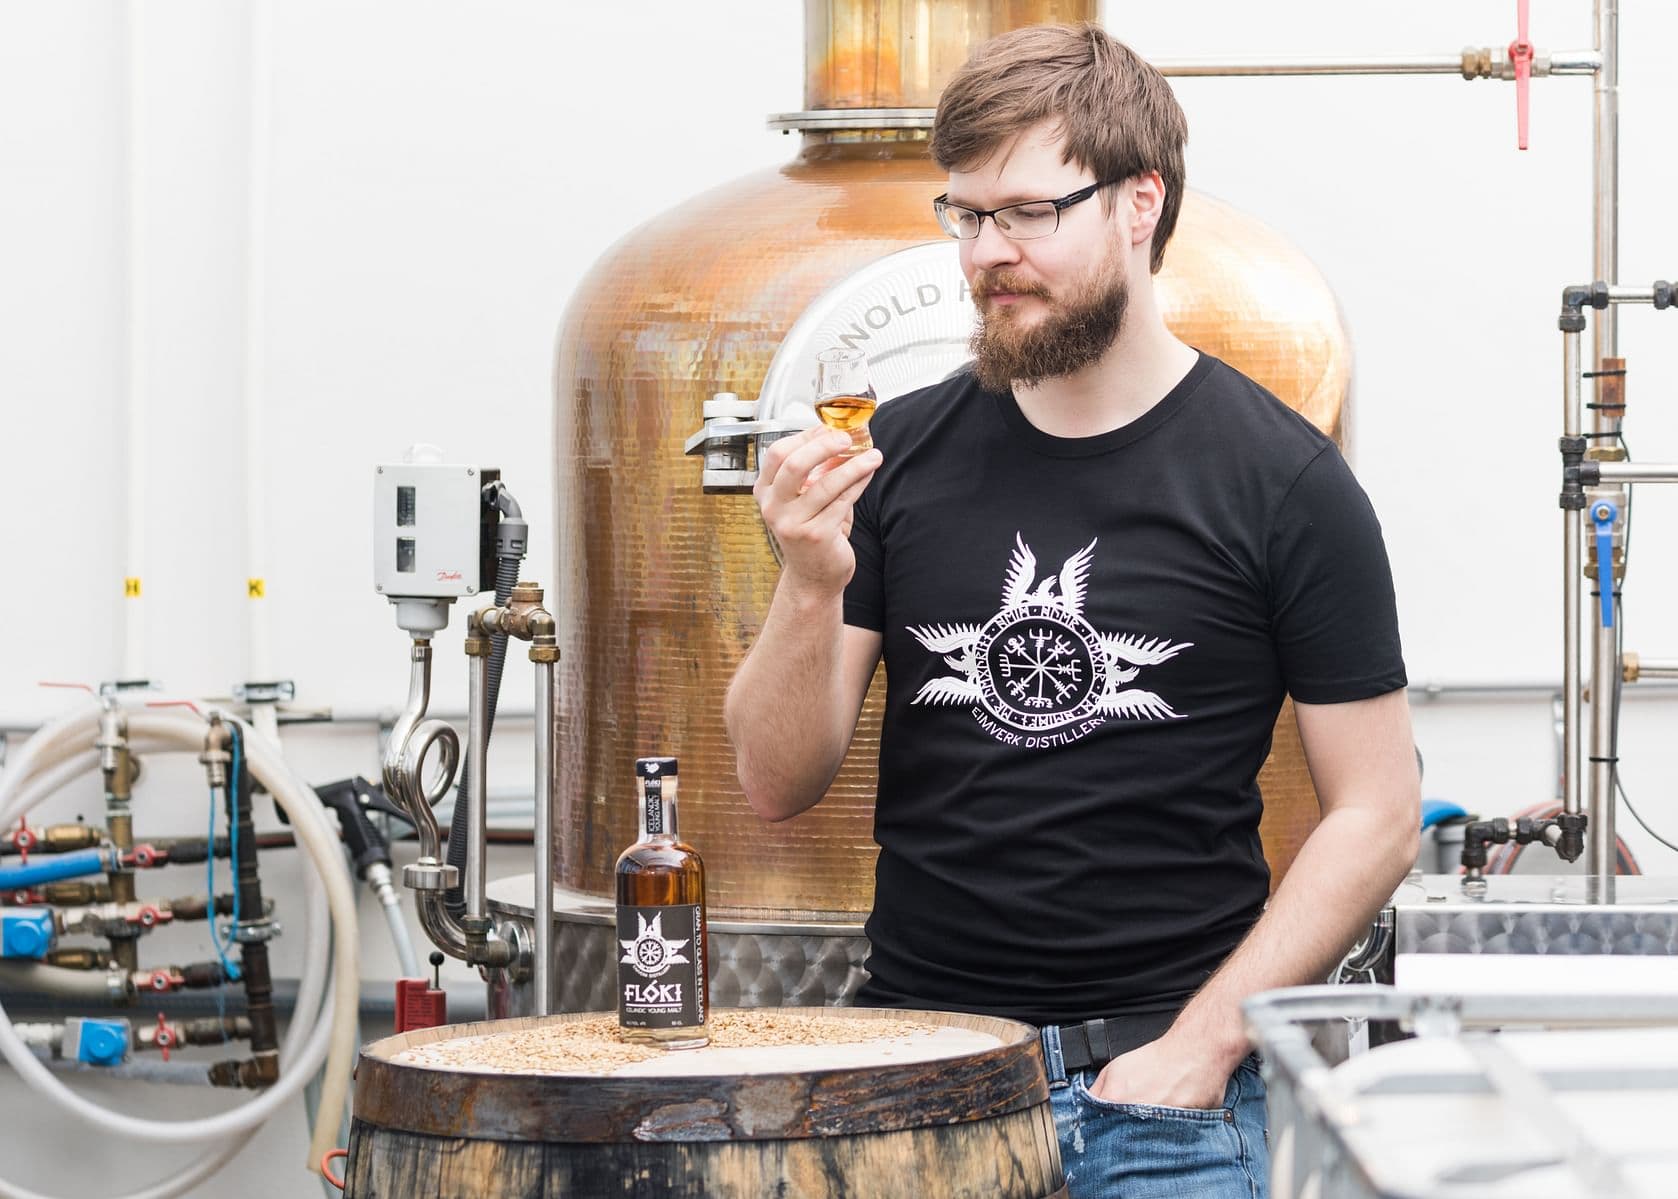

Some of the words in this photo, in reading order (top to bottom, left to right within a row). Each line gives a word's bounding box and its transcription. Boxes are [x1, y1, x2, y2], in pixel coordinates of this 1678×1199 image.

[971, 706, 1023, 746] EIMVERK
[1026, 716, 1107, 748] DISTILLERY
[624, 980, 682, 1003] FLÓKI
